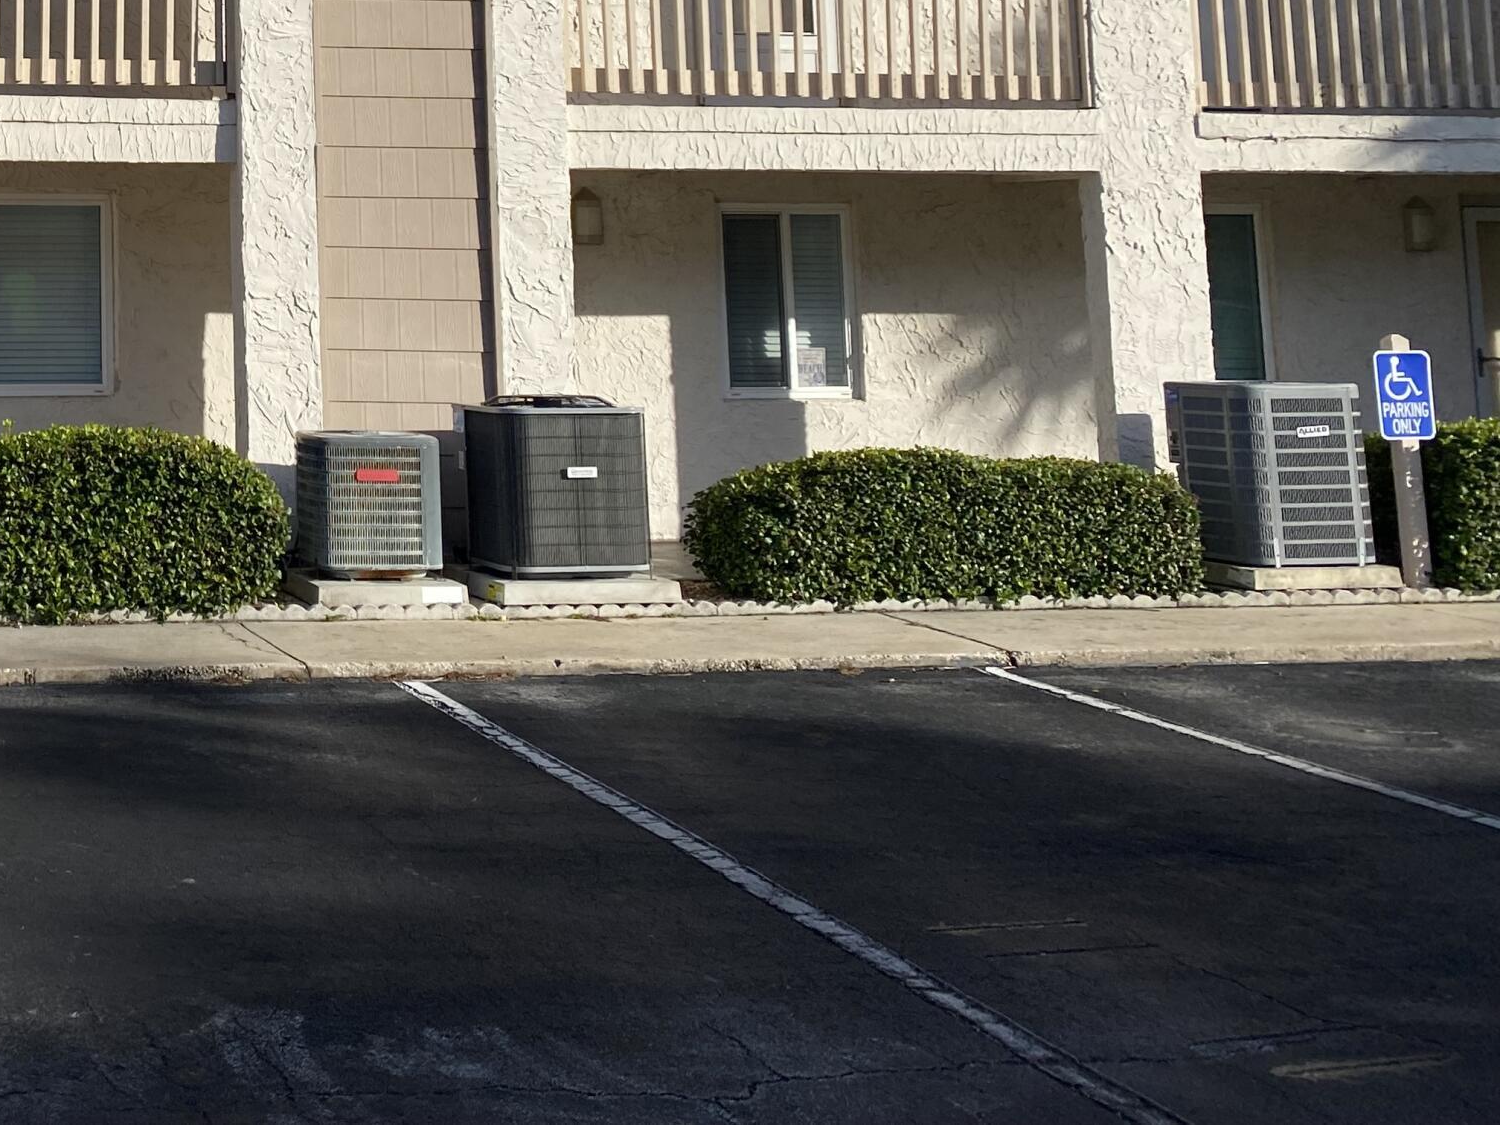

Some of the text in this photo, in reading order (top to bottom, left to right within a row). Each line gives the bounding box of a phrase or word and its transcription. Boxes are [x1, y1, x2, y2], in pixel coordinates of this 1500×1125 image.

[1382, 402, 1429, 418] PARKING
[1299, 427, 1327, 435] ALLIED
[1392, 419, 1422, 435] ONLY
